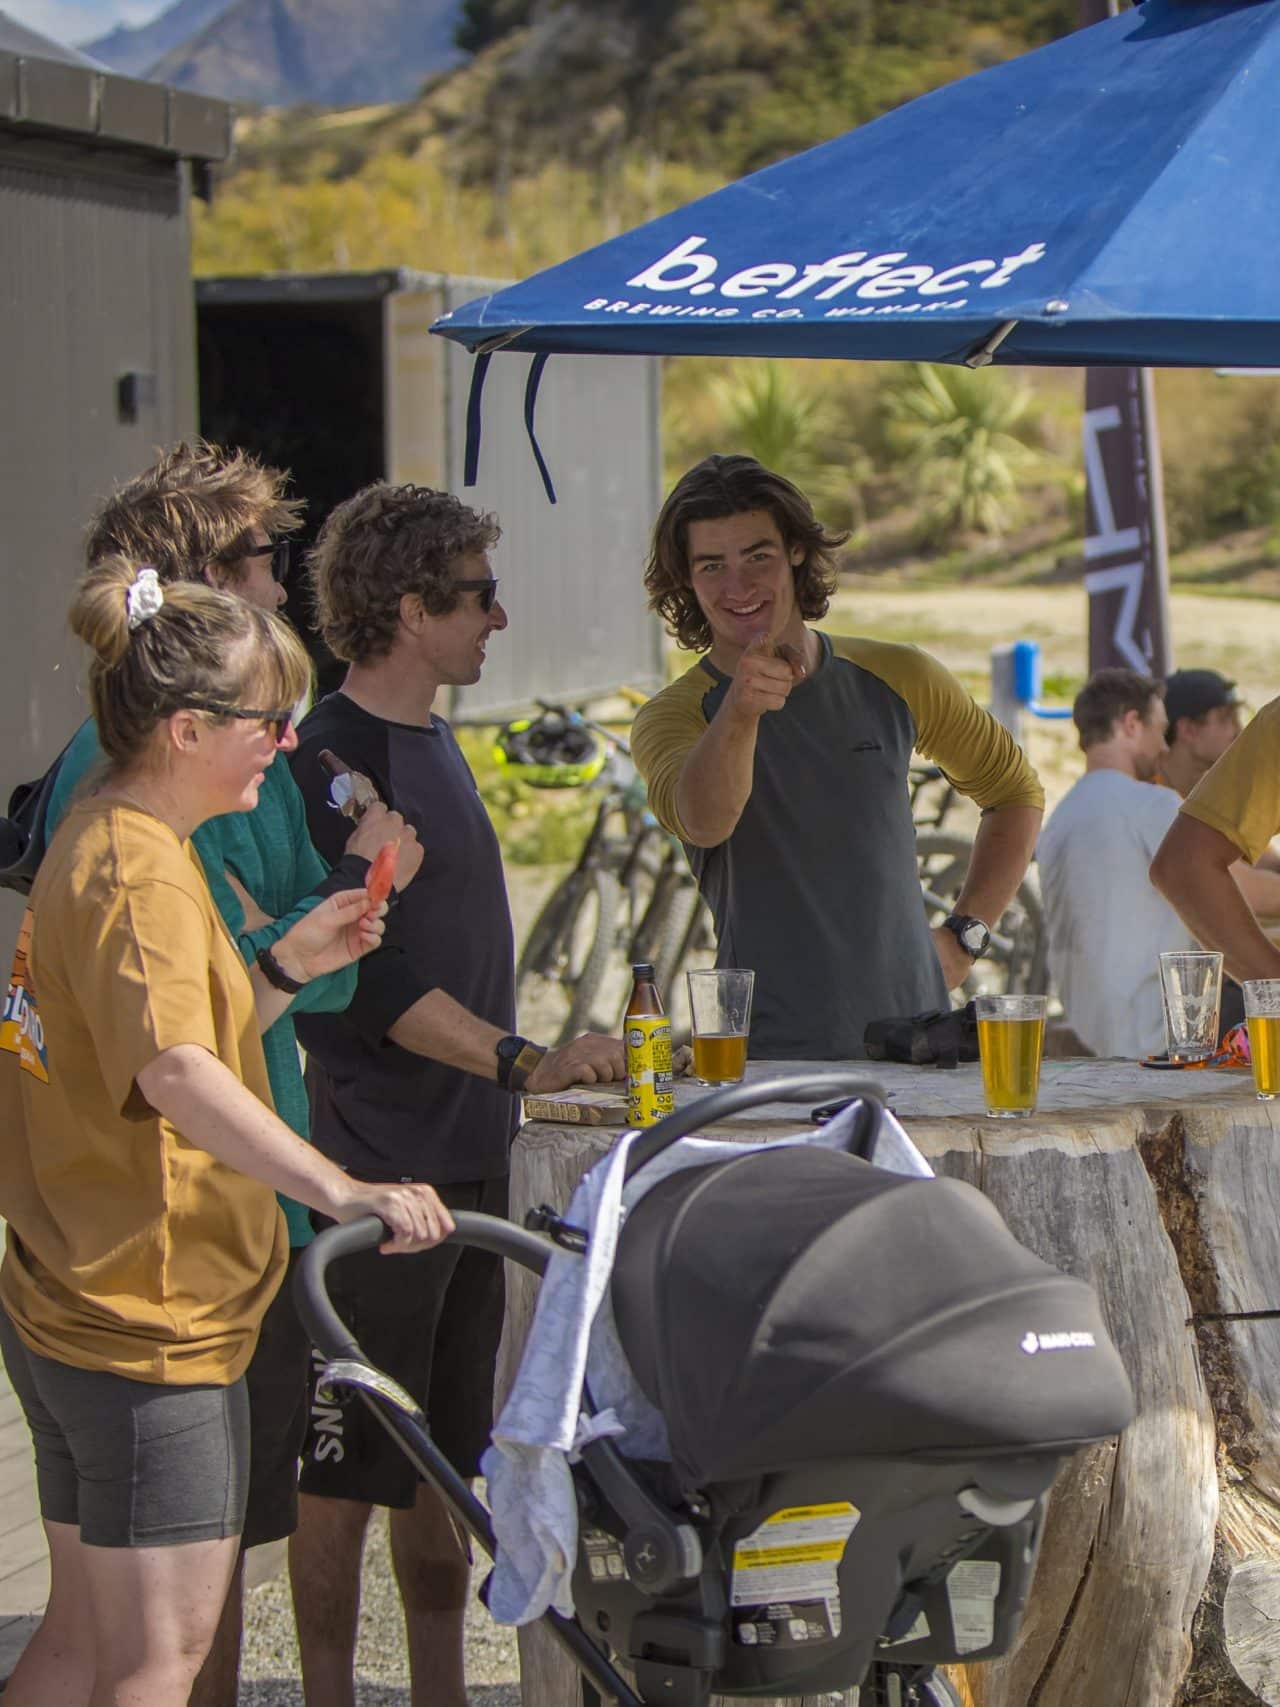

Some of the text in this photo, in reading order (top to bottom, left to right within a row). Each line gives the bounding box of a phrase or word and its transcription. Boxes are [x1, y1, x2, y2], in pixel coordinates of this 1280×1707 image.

[626, 235, 1046, 299] b.effect
[583, 298, 968, 319] BREWING CO. WANAKA
